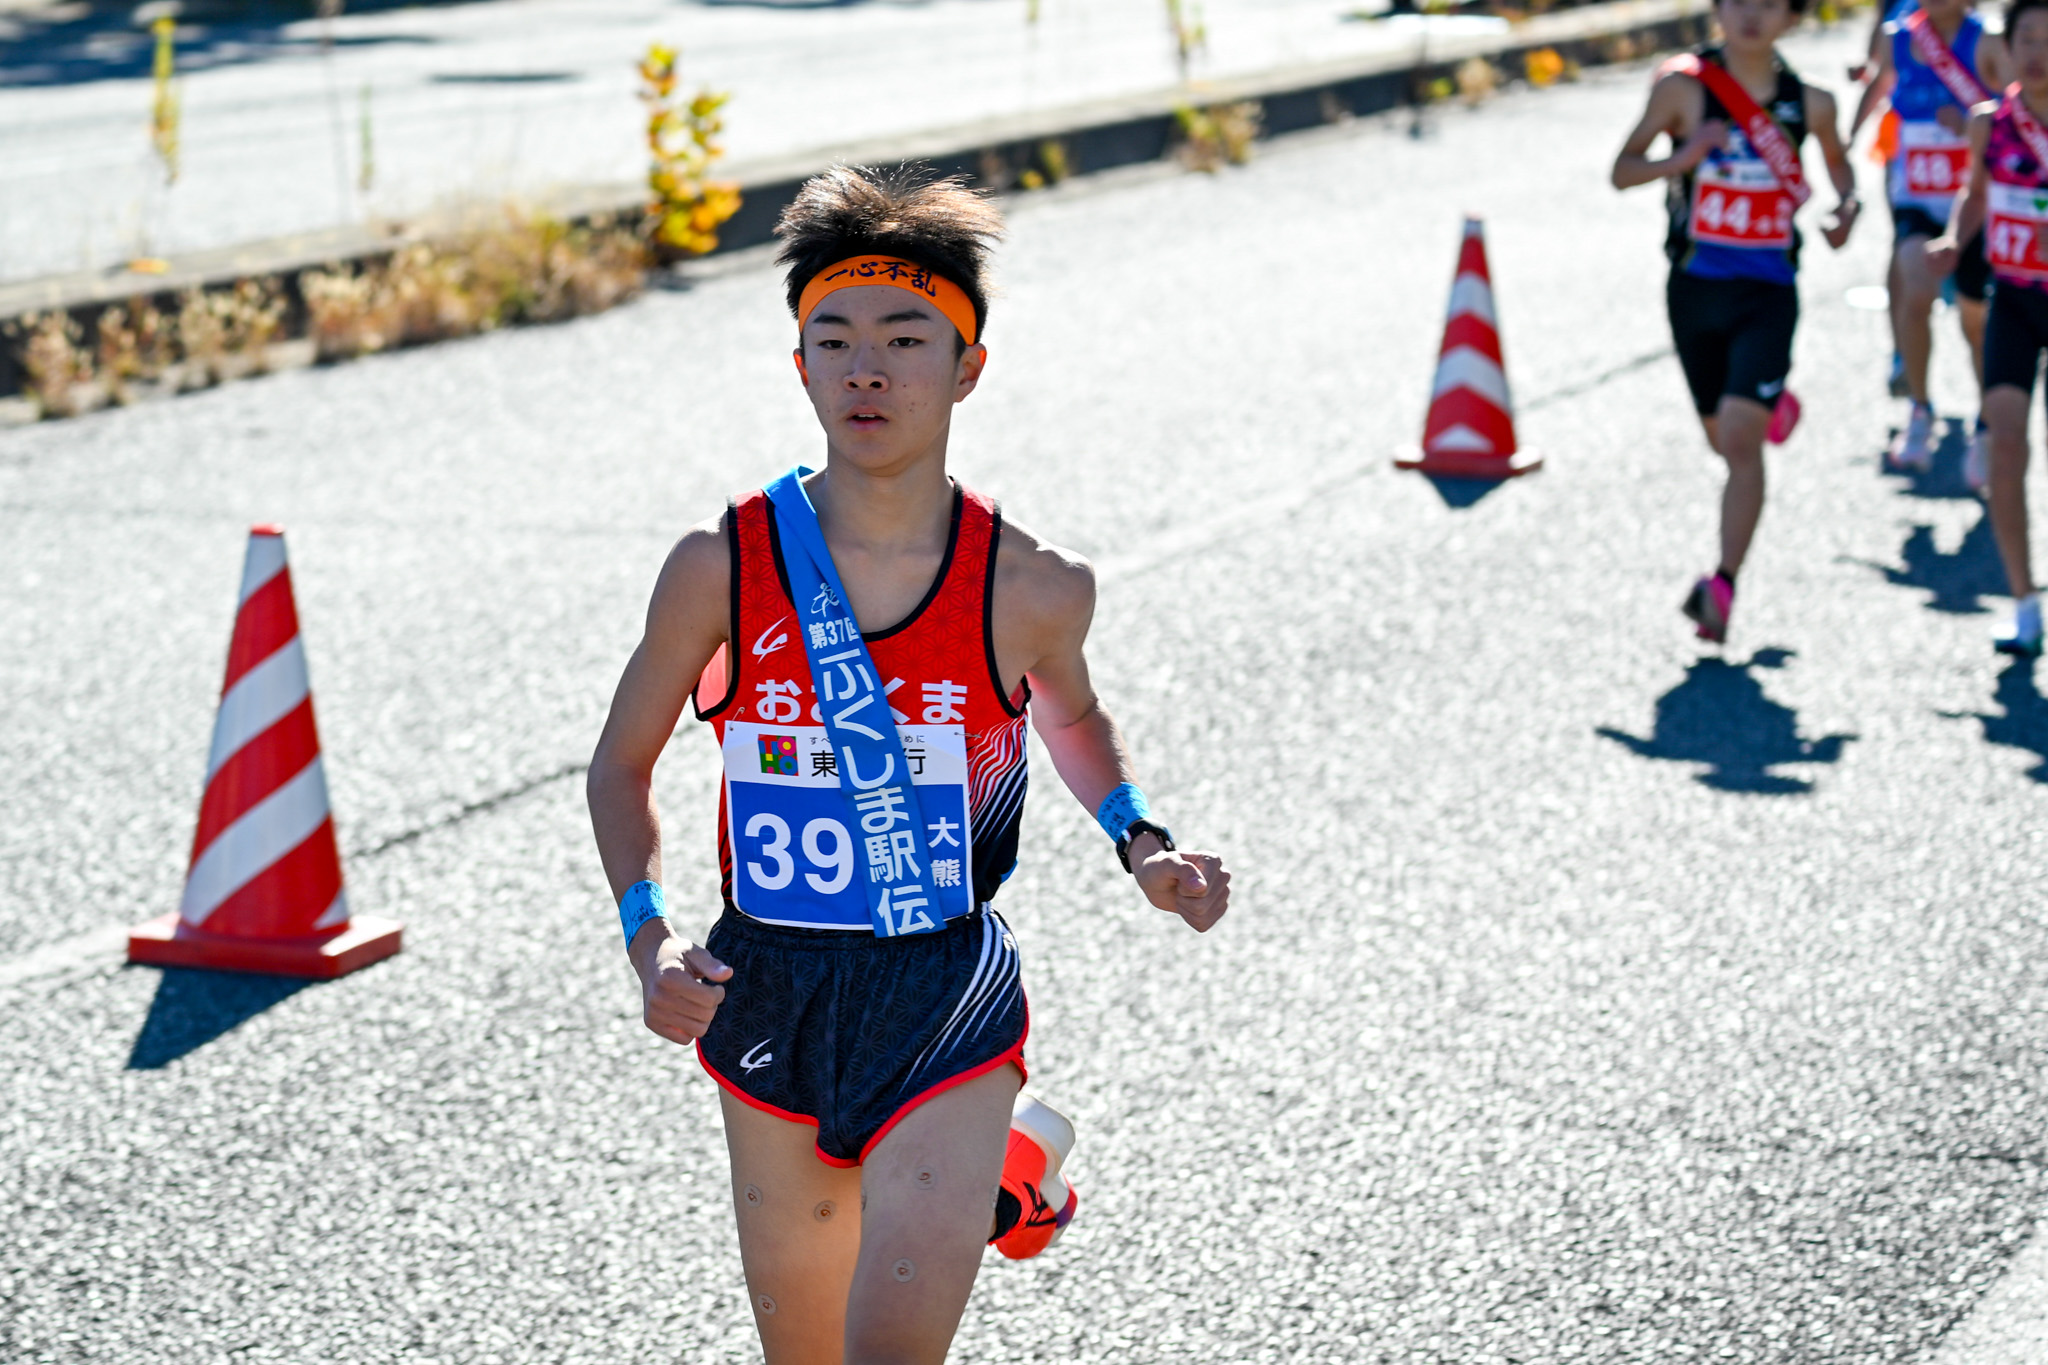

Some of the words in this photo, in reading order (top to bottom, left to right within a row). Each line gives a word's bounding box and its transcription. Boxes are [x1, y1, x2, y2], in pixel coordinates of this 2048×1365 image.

[1700, 190, 1751, 235] 44
[1994, 220, 2032, 264] 47
[825, 261, 936, 297] 一心不乱
[755, 677, 968, 724] おくま
[810, 747, 926, 777] 東行
[818, 648, 936, 937] ふくしま駅伝
[745, 813, 854, 895] 39
[927, 817, 961, 888] 大熊
